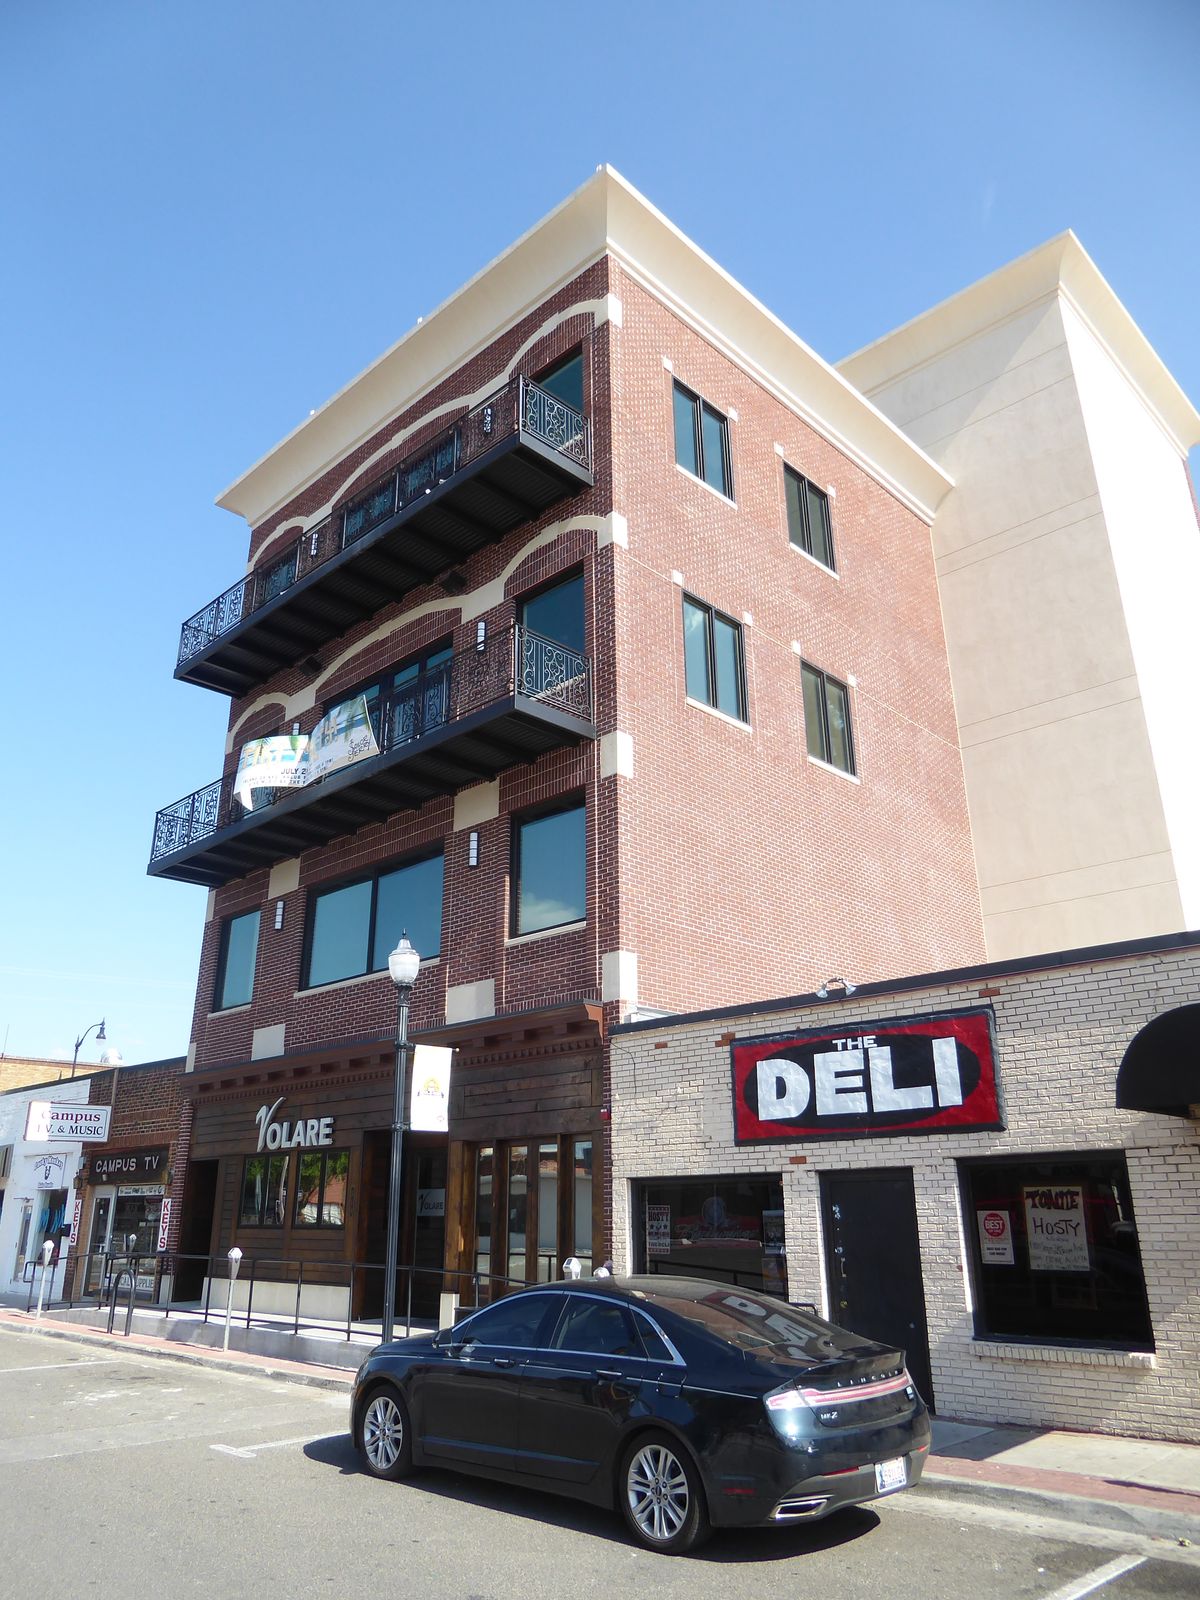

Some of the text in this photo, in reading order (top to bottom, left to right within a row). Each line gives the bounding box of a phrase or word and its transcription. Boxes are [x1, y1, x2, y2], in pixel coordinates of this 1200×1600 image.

[832, 1035, 878, 1051] THE
[756, 1037, 963, 1121] DELI
[57, 1125, 65, 1133] &
[68, 1125, 104, 1135] MUSIC
[255, 1096, 334, 1153] VOLARE
[95, 1156, 159, 1173] CAMPUS TV
[418, 1190, 443, 1214] VOLARE
[70, 1201, 81, 1243] KEYS
[158, 1200, 169, 1249] KEYS
[985, 1220, 1003, 1230] BEST
[1032, 1216, 1080, 1236] HOSTY
[837, 1369, 899, 1388] LINCOLN
